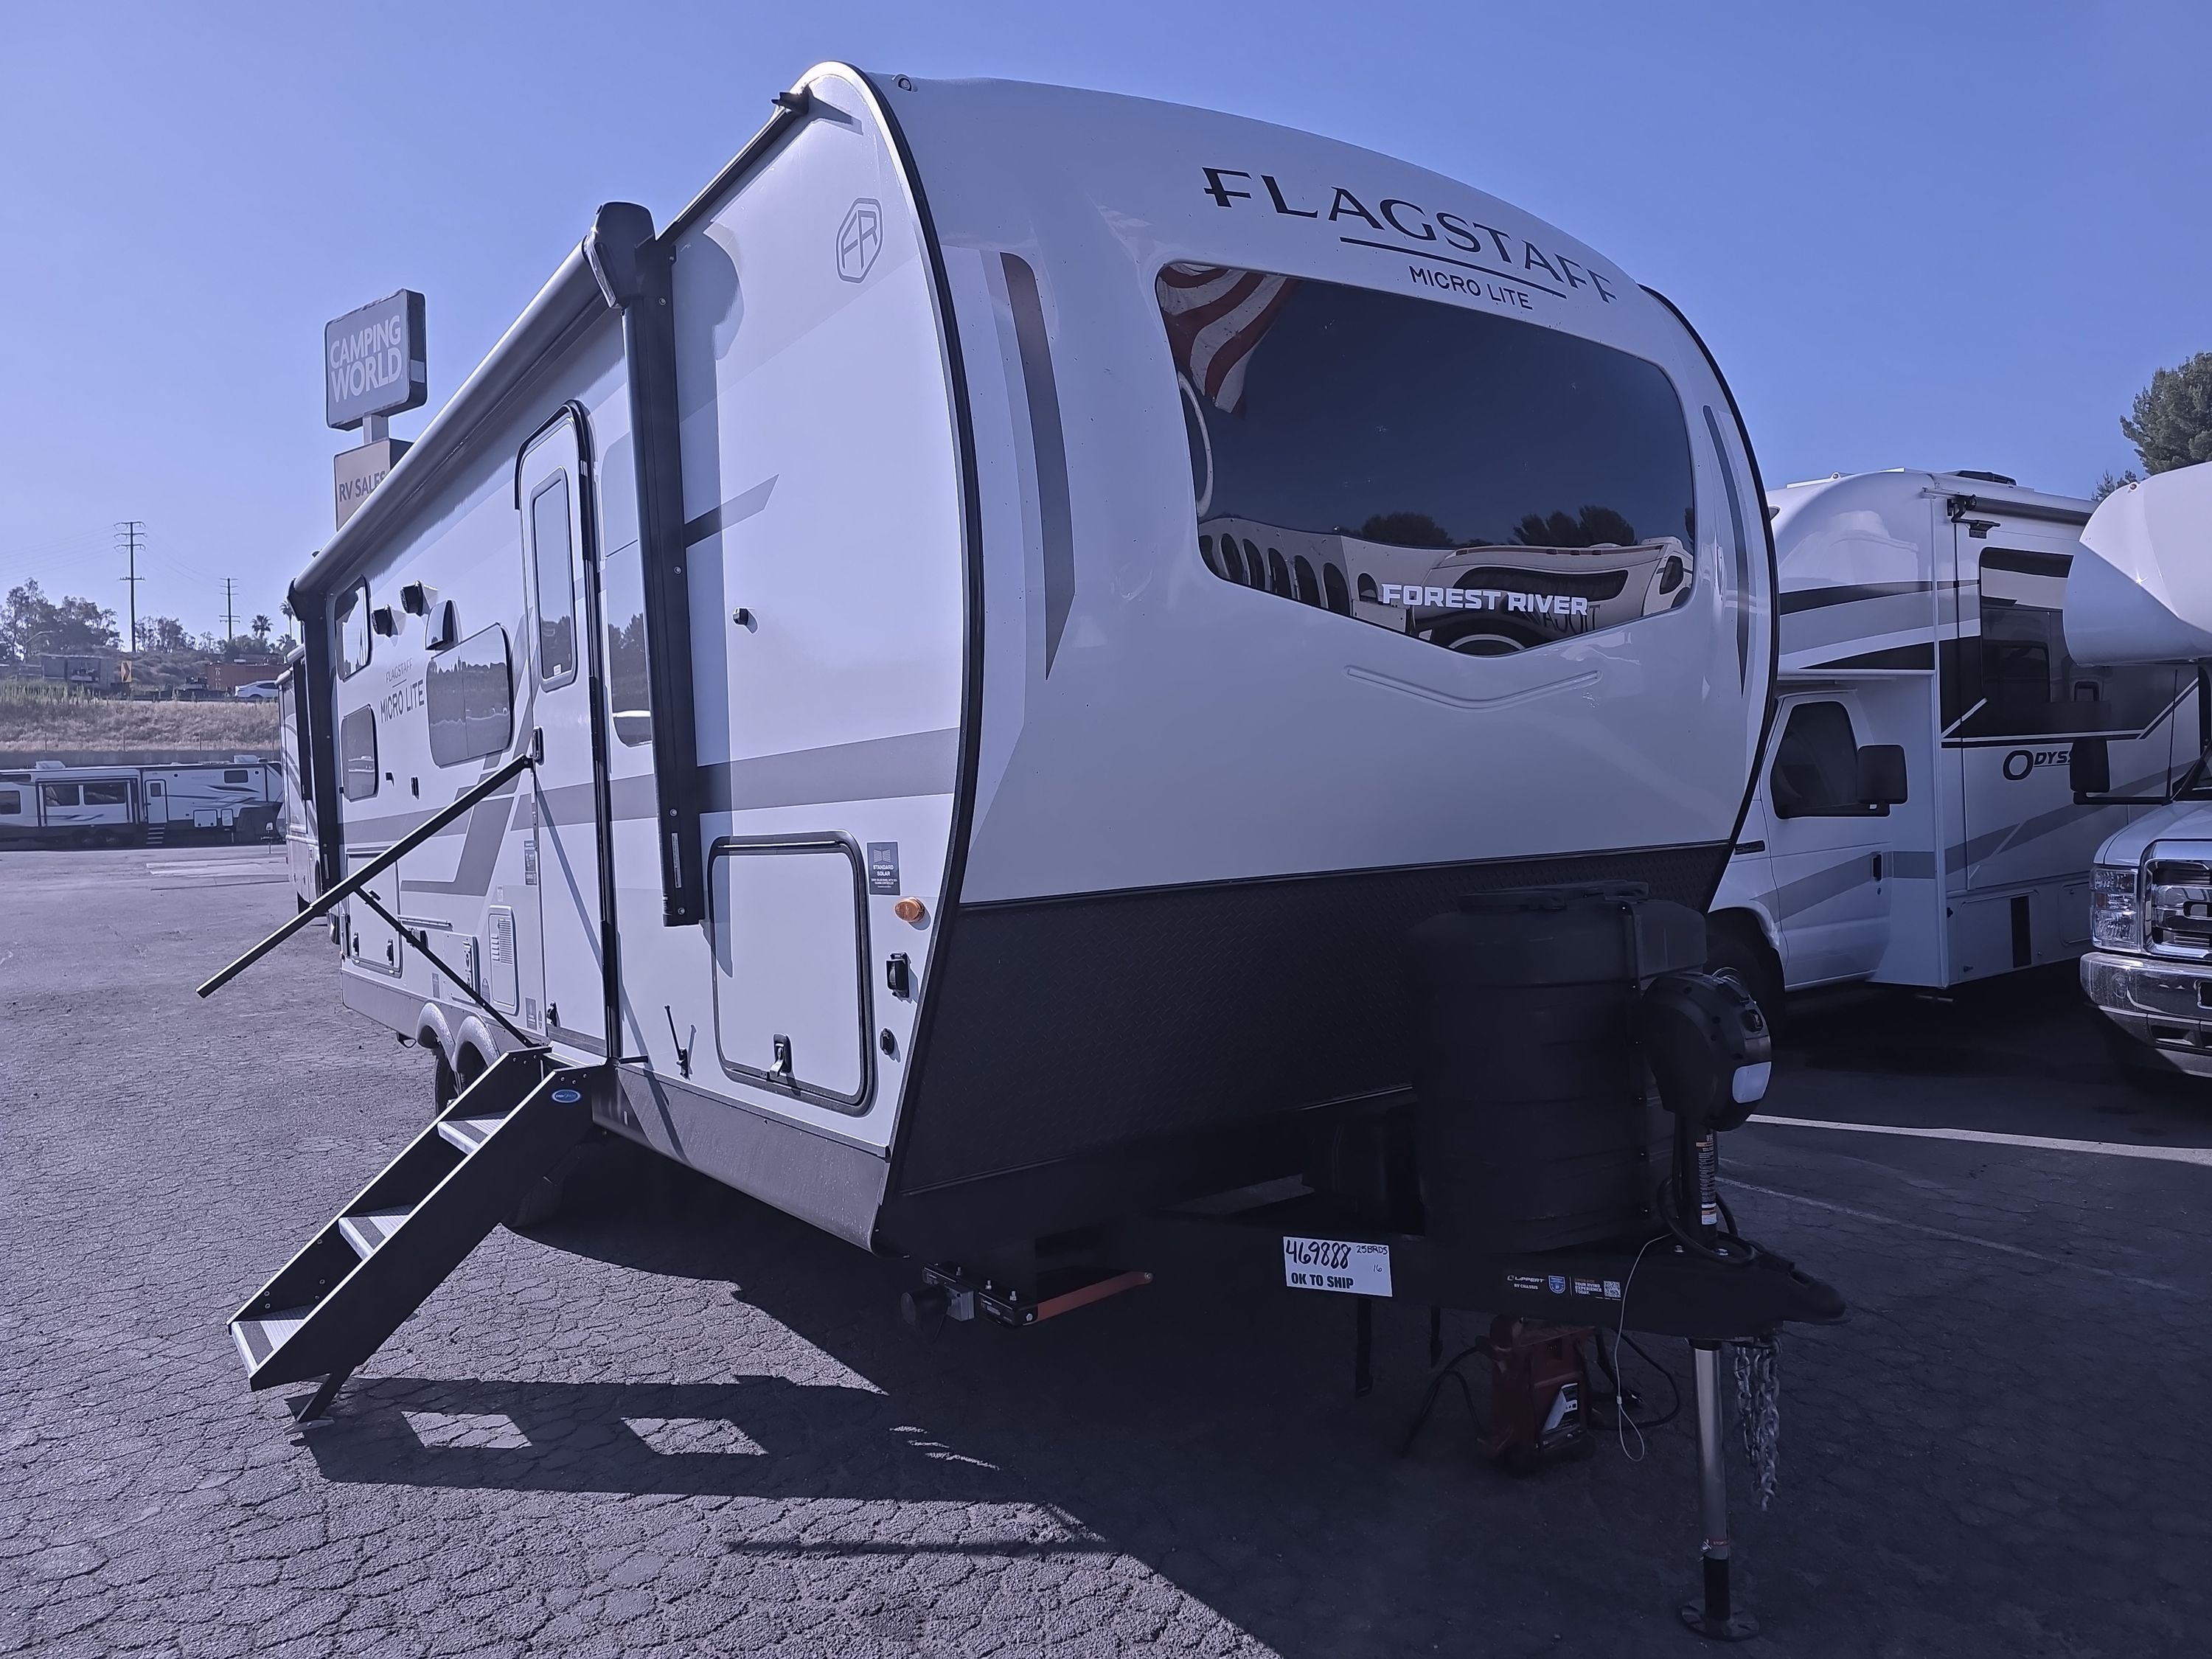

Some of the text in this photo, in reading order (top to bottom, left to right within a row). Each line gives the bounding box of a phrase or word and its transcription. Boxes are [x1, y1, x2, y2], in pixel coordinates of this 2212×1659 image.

[1202, 167, 1618, 304] FLAGSTAFF
[1409, 265, 1533, 311] MICRO LITE
[330, 315, 402, 369] CAMPING
[330, 347, 402, 403] WORLD
[338, 482, 352, 502] RV
[1382, 583, 1588, 616] FOREST RIVER
[386, 657, 413, 683] FLAGSTAFF
[380, 679, 425, 723] MICRO LITE
[2003, 749, 2072, 780] ODYS
[1285, 1239, 1352, 1270] 469888
[1291, 1273, 1354, 1289] OK TO SHIP
